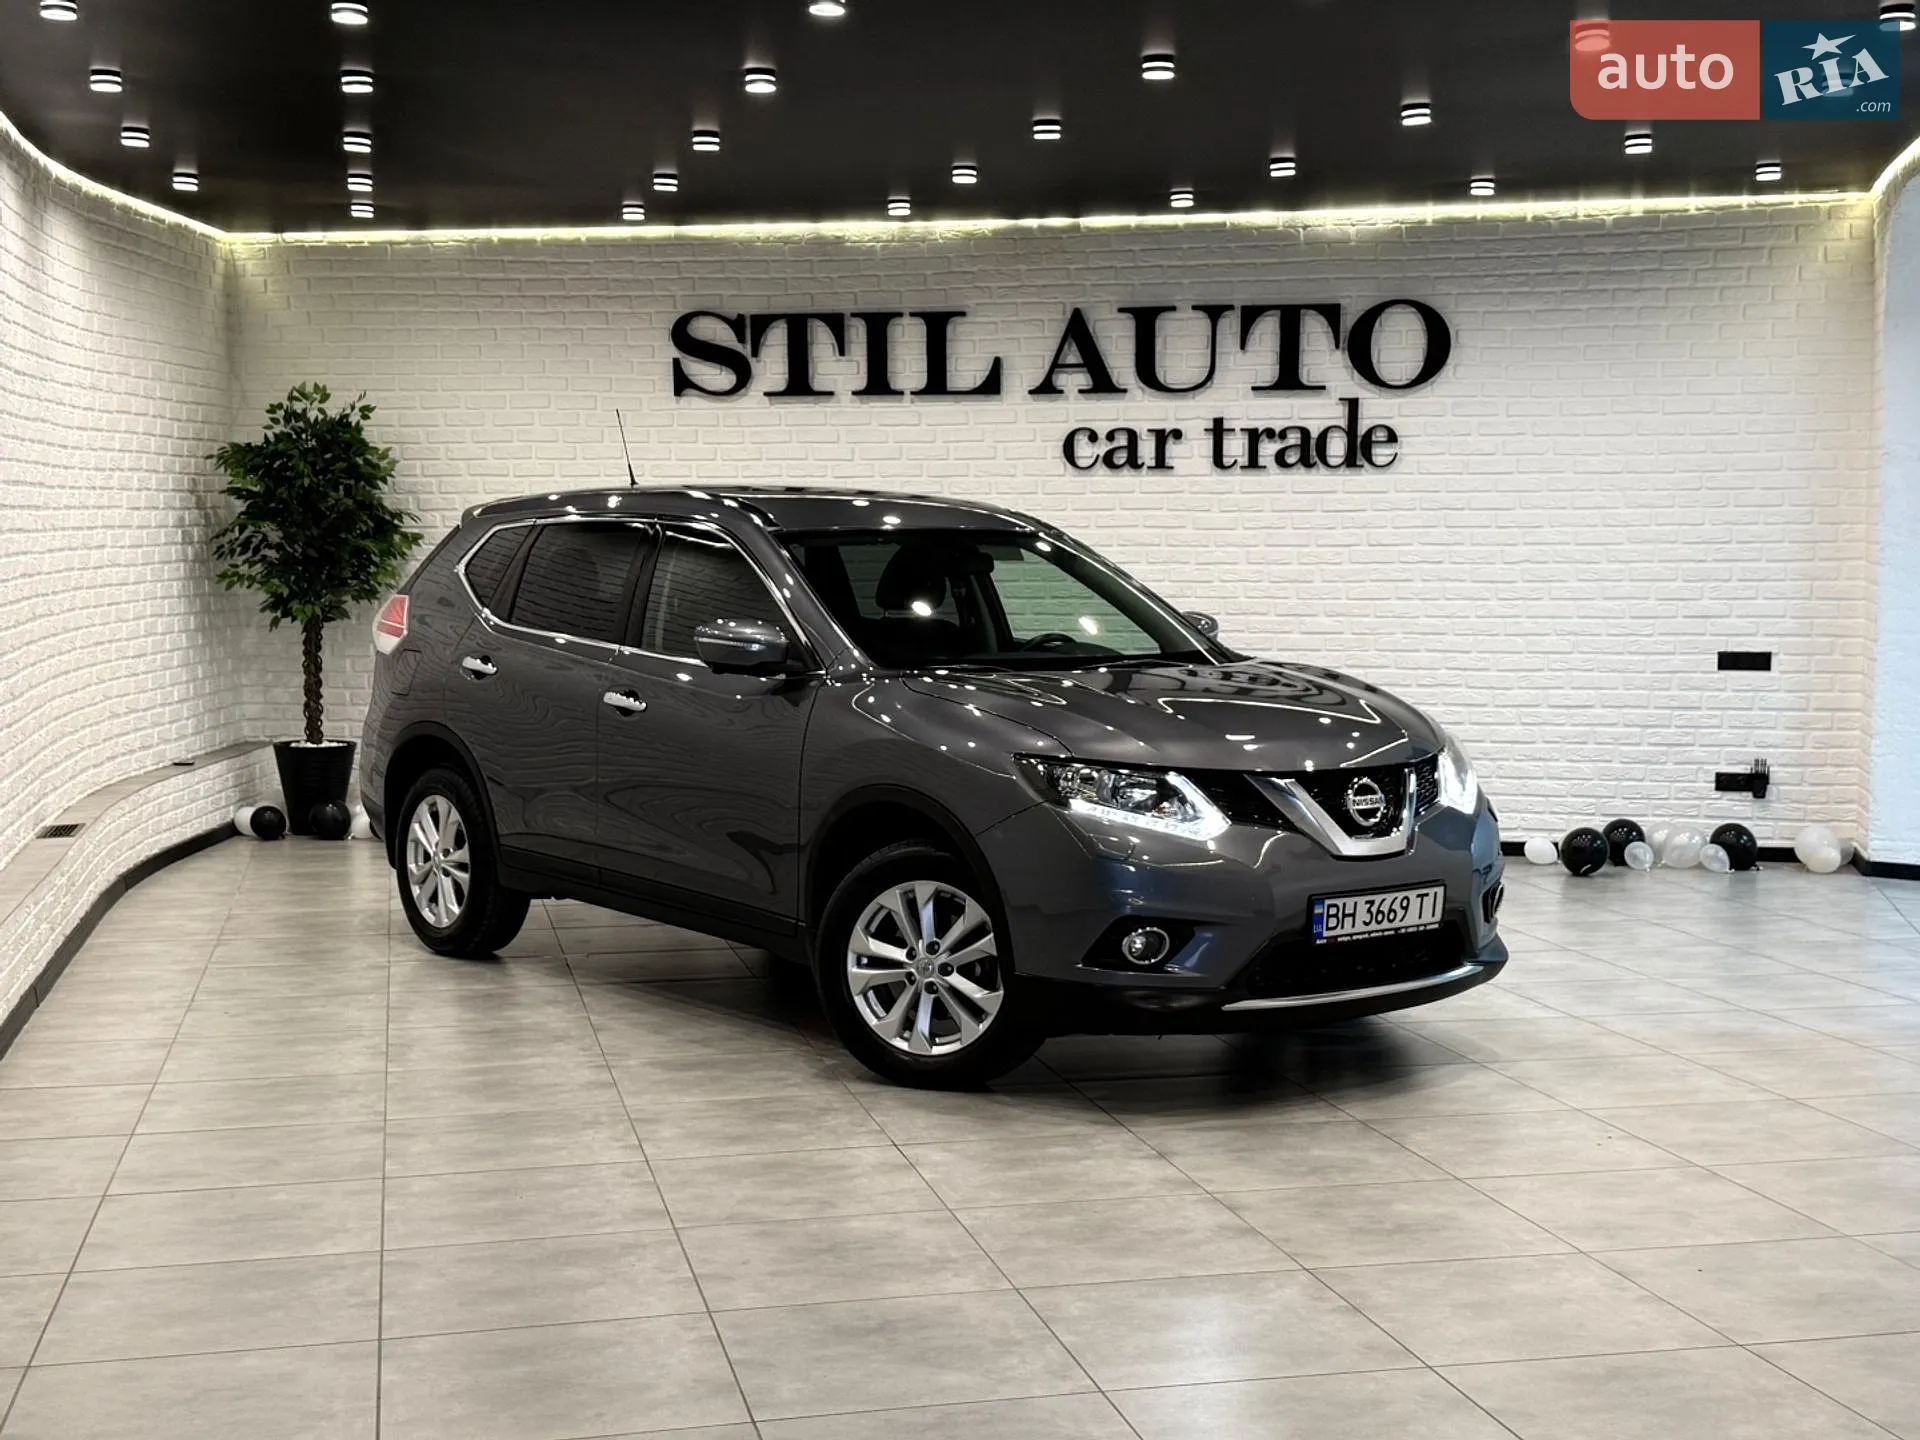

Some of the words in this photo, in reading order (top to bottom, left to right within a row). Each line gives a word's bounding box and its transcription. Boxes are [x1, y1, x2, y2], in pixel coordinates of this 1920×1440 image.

[670, 309, 1002, 397] STIL
[1028, 298, 1452, 395] AUTO
[1062, 426, 1183, 470] car
[1205, 398, 1399, 470] trade
[1325, 901, 1358, 931] BH
[1362, 895, 1410, 926] 3669
[1416, 891, 1438, 920] TI
